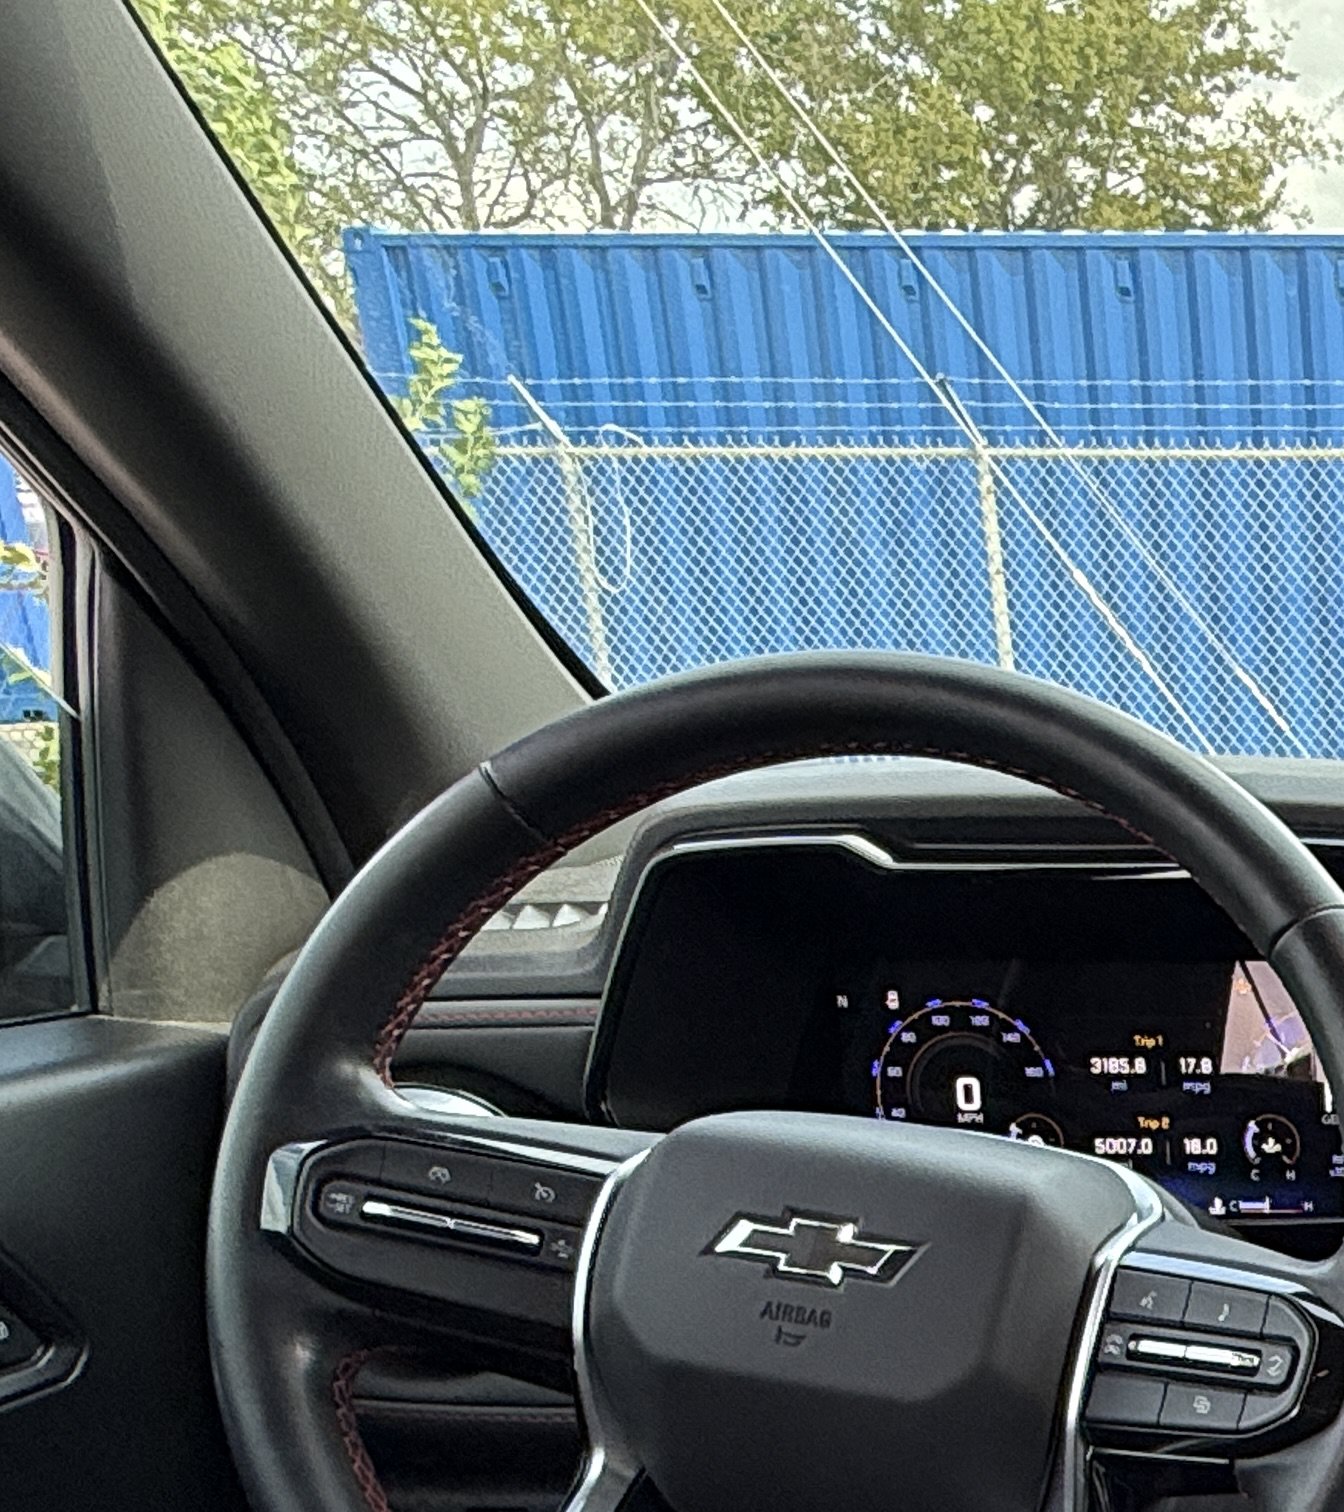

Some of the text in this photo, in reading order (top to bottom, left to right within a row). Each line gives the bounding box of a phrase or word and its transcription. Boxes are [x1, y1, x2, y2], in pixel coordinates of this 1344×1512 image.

[1133, 1035, 1156, 1049] Trip
[955, 1076, 982, 1112] 0
[1137, 1116, 1160, 1131] Trip
[1094, 1137, 1153, 1155] 5007.0
[760, 1301, 833, 1329] AIRBAG
